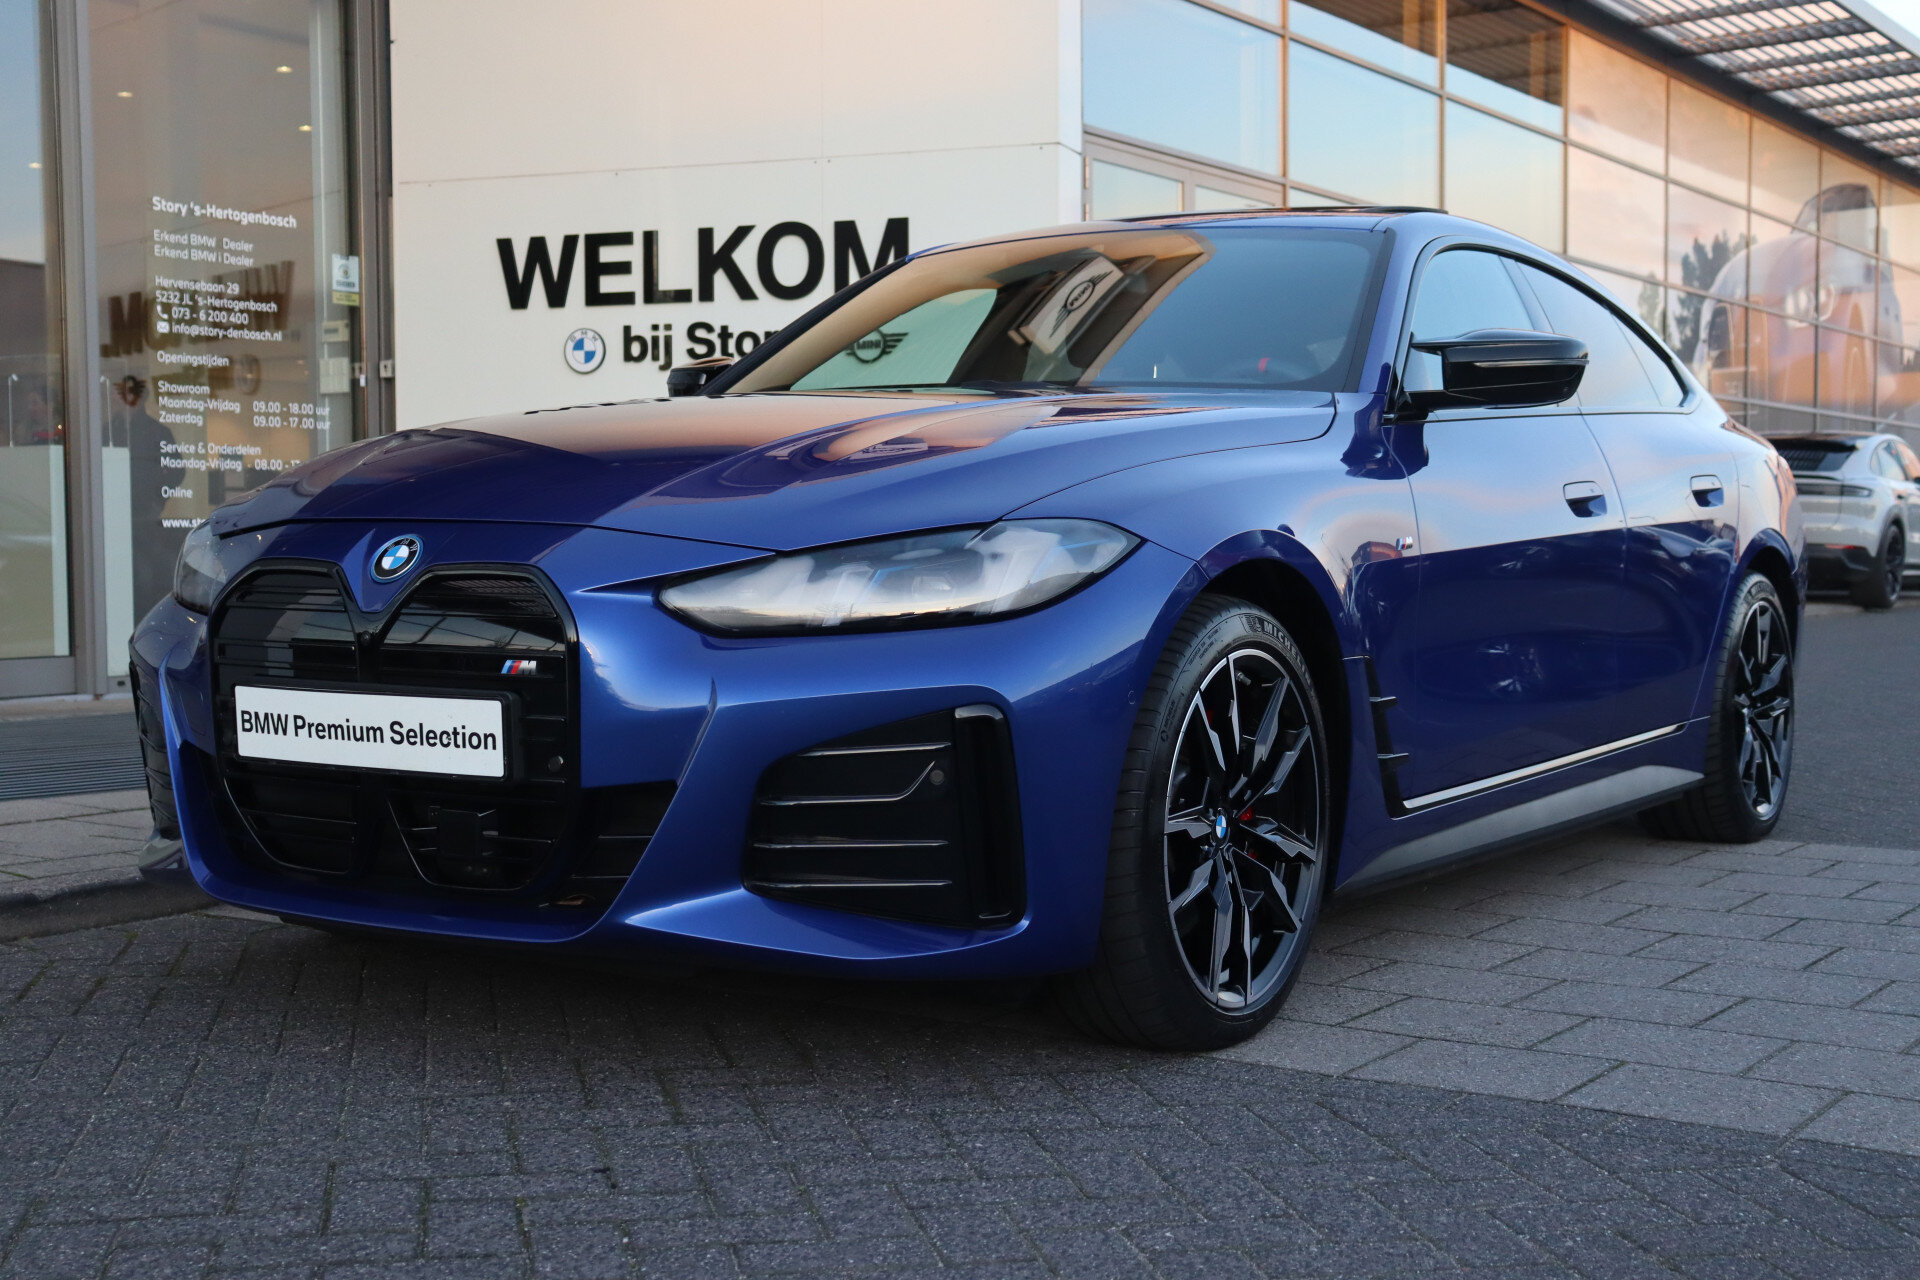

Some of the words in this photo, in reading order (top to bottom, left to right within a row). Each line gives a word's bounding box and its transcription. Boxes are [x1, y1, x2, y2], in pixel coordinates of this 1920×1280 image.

[152, 196, 188, 217] Story
[153, 229, 188, 244] Erkend
[190, 233, 216, 247] BMW
[223, 238, 253, 252] Dealer
[154, 245, 188, 260] Erkend
[190, 249, 216, 262] BMW
[223, 252, 254, 267] Dealer
[496, 217, 909, 310] WELKOM
[155, 276, 225, 292] Hervensebaan
[226, 282, 240, 295] 29
[155, 289, 180, 304] 5232
[182, 293, 193, 305] JL
[171, 306, 190, 319] 073
[199, 311, 206, 322] 6
[208, 311, 227, 323] 200
[229, 312, 249, 324] 400
[172, 322, 282, 342] info@story-denbosch.nl
[622, 323, 673, 371] bij
[156, 350, 230, 368] Openingstijden
[157, 380, 210, 395] Showroom
[158, 396, 241, 413] Maandag-Vrijdag
[252, 400, 281, 413] 09.00
[289, 402, 314, 415] 18.00
[159, 411, 203, 427] Zaterdag
[253, 415, 281, 428] 09.00
[159, 440, 195, 453] Service
[197, 442, 205, 454] &
[207, 442, 262, 456] Onderdelen
[160, 456, 242, 472] Maandag-Vrijdag
[254, 459, 283, 471] 08.00
[161, 485, 193, 499] Online
[240, 710, 289, 737] BMW
[293, 714, 385, 744] Premium
[389, 720, 497, 751] Selection
